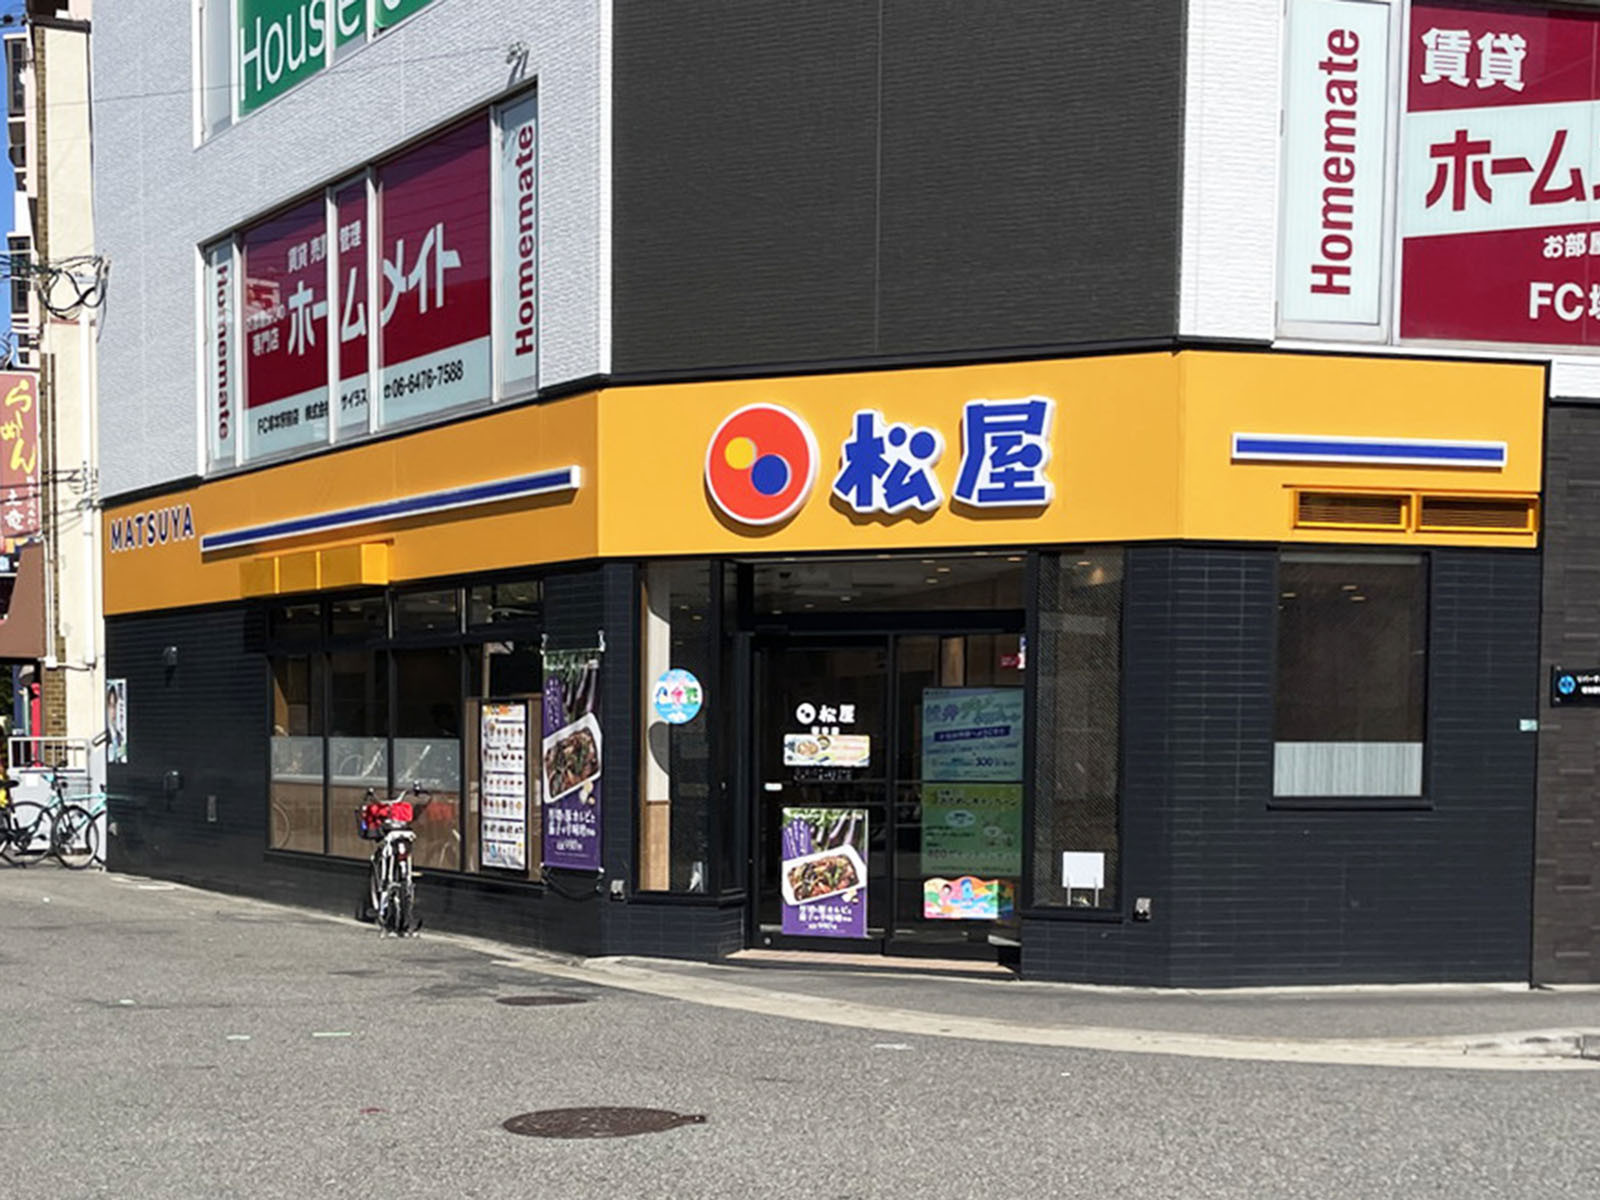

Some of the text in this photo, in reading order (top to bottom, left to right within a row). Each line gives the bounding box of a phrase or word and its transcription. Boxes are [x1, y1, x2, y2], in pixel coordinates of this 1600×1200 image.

[1421, 27, 1527, 92] 賃貸
[1309, 28, 1361, 296] Homemate
[1425, 128, 1600, 212] ホーム
[287, 222, 462, 356] ホームメイト
[516, 124, 535, 356] Homemate
[216, 264, 230, 440] Homemate
[392, 359, 464, 398] 06-6476-7588
[833, 396, 1054, 513] 松屋
[109, 502, 195, 553] MATSUYA
[818, 703, 856, 724] 松屋
